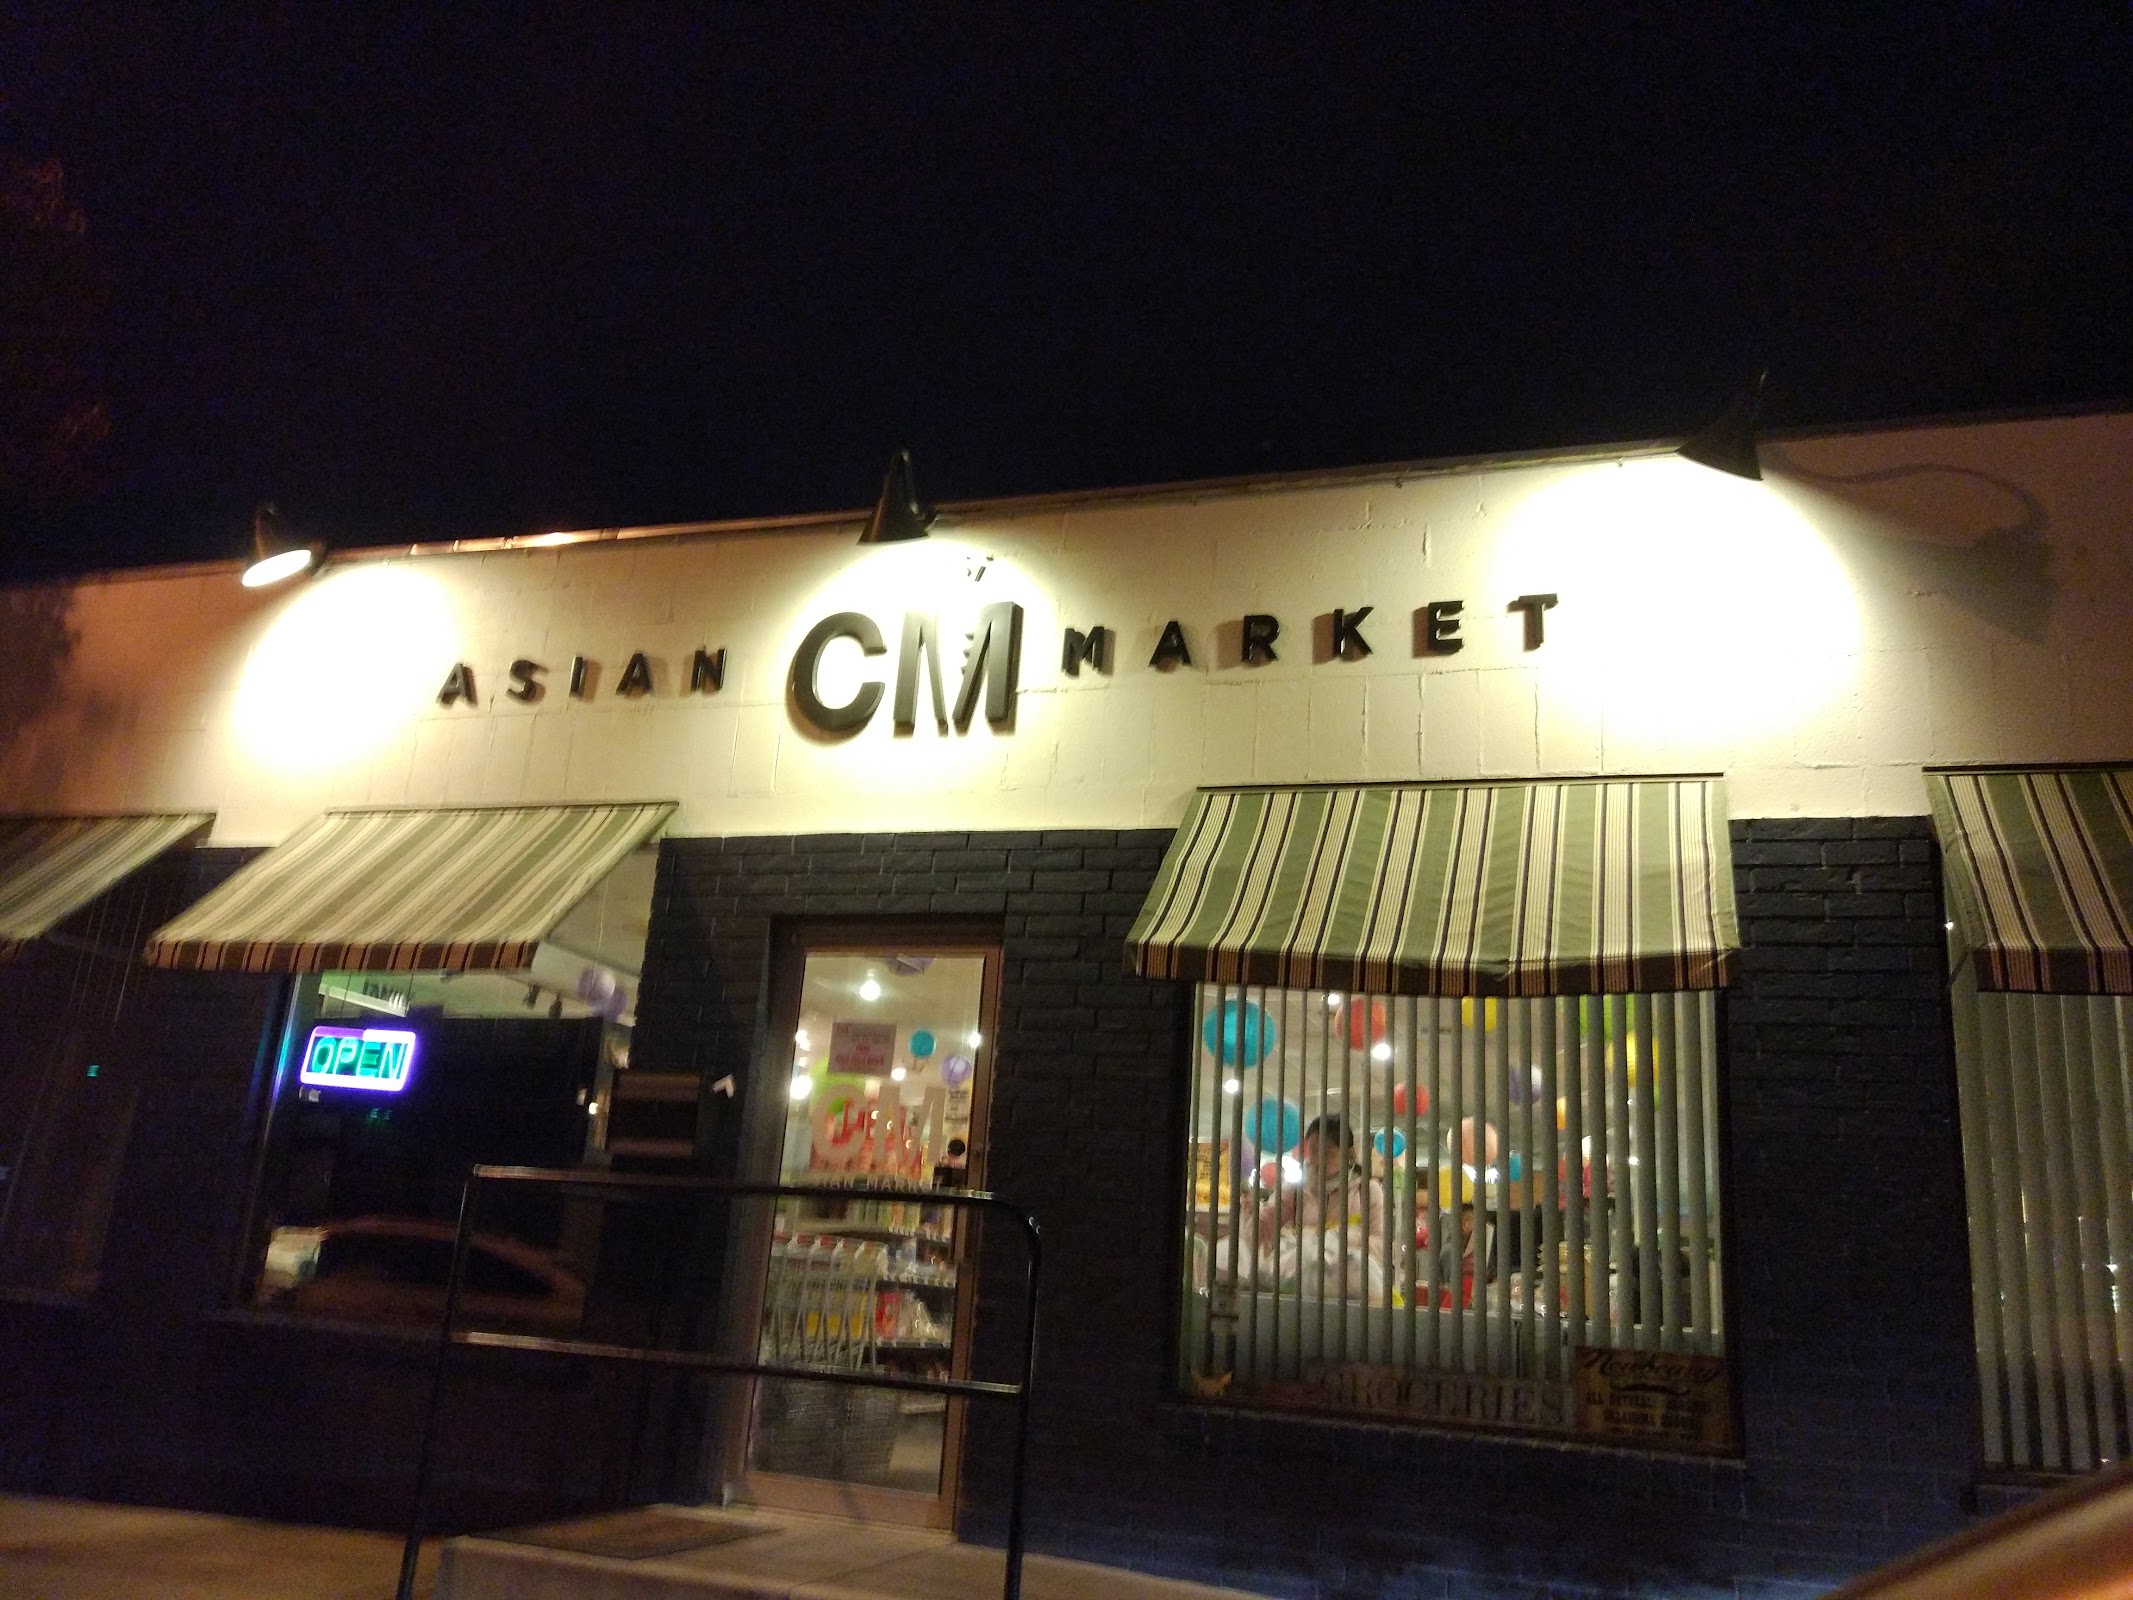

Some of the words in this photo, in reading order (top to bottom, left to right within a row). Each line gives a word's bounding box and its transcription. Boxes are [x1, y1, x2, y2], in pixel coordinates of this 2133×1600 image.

[437, 646, 728, 706] ASIAN
[789, 601, 1023, 739] CM
[1062, 593, 1558, 678] MARKET
[311, 1035, 408, 1080] OPEN
